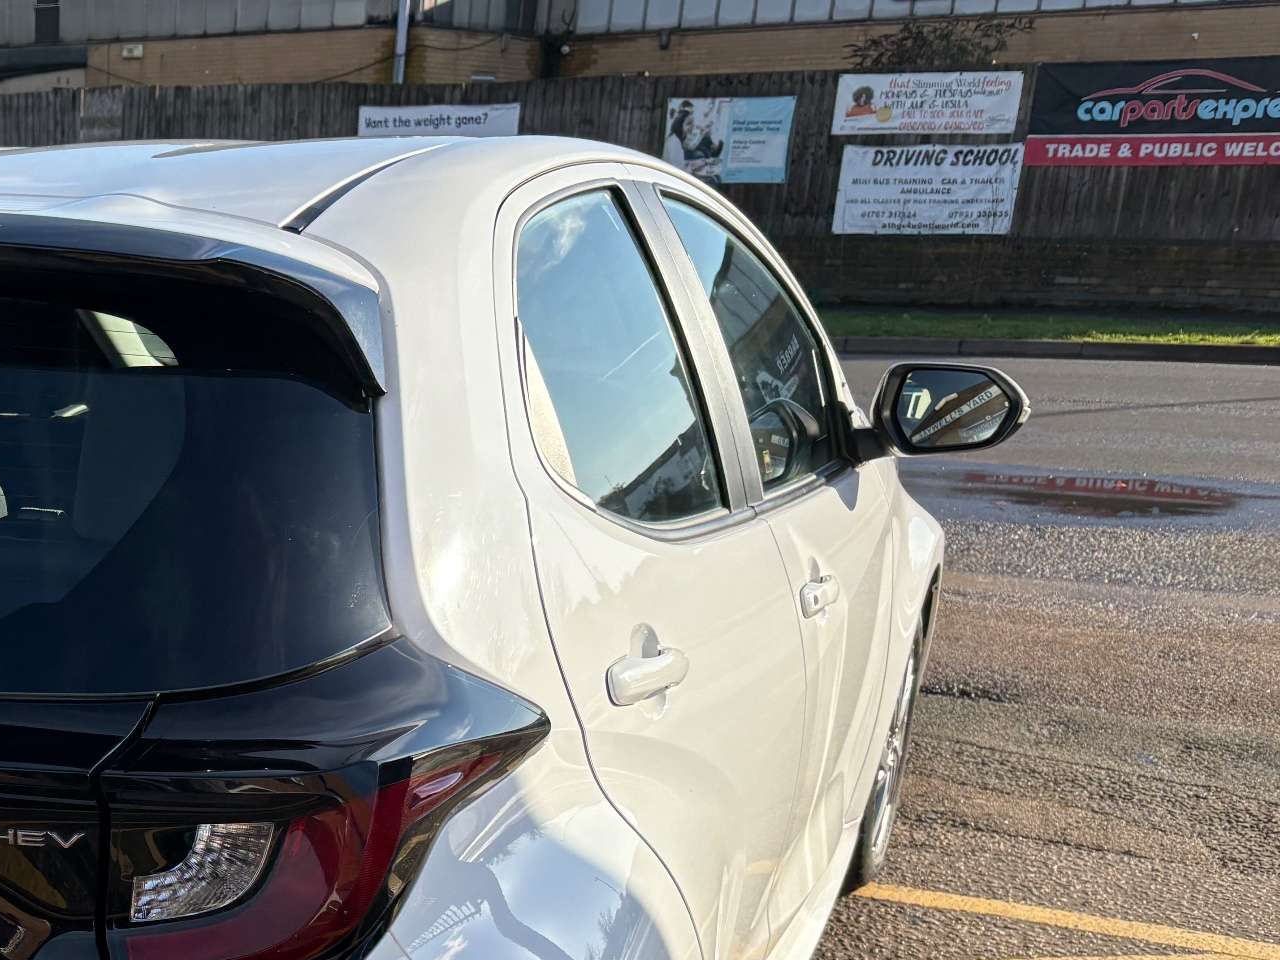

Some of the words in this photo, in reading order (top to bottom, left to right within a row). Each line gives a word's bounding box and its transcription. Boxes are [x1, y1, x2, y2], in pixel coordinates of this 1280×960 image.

[912, 78, 953, 91] Slimming
[955, 77, 981, 89] World
[364, 116, 389, 129] Want
[393, 115, 411, 128] the
[414, 113, 452, 129] weight
[455, 113, 488, 128] gone?
[871, 149, 948, 167] DRIVING
[950, 147, 1019, 167] SCHOOL
[1045, 143, 1112, 158] TRADE
[1117, 142, 1132, 158] &
[1139, 142, 1218, 158] PUBLIC
[1224, 142, 1280, 157] WELC
